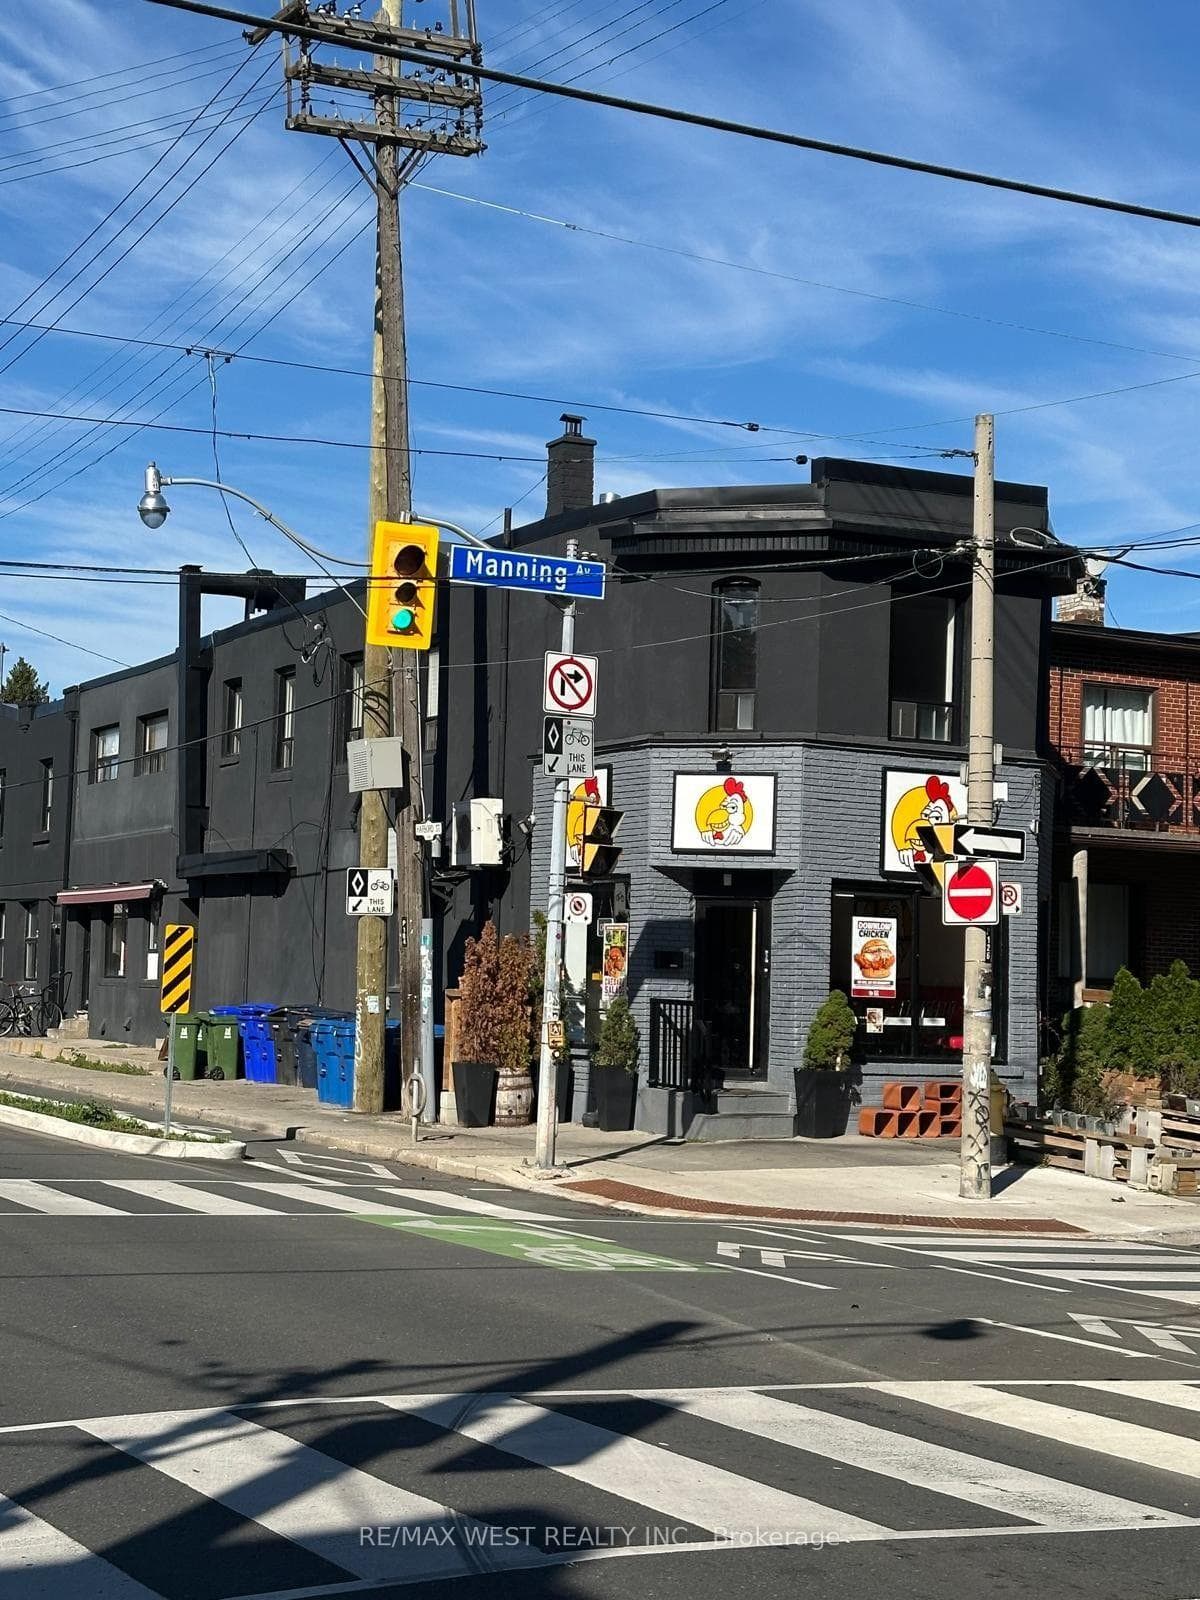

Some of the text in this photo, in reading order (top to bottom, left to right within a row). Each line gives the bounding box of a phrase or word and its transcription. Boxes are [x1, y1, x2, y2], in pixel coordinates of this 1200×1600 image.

[466, 550, 591, 590] Manning Av
[569, 753, 585, 762] THIS
[567, 764, 587, 775] LANE
[859, 930, 890, 939] CHICKEN
